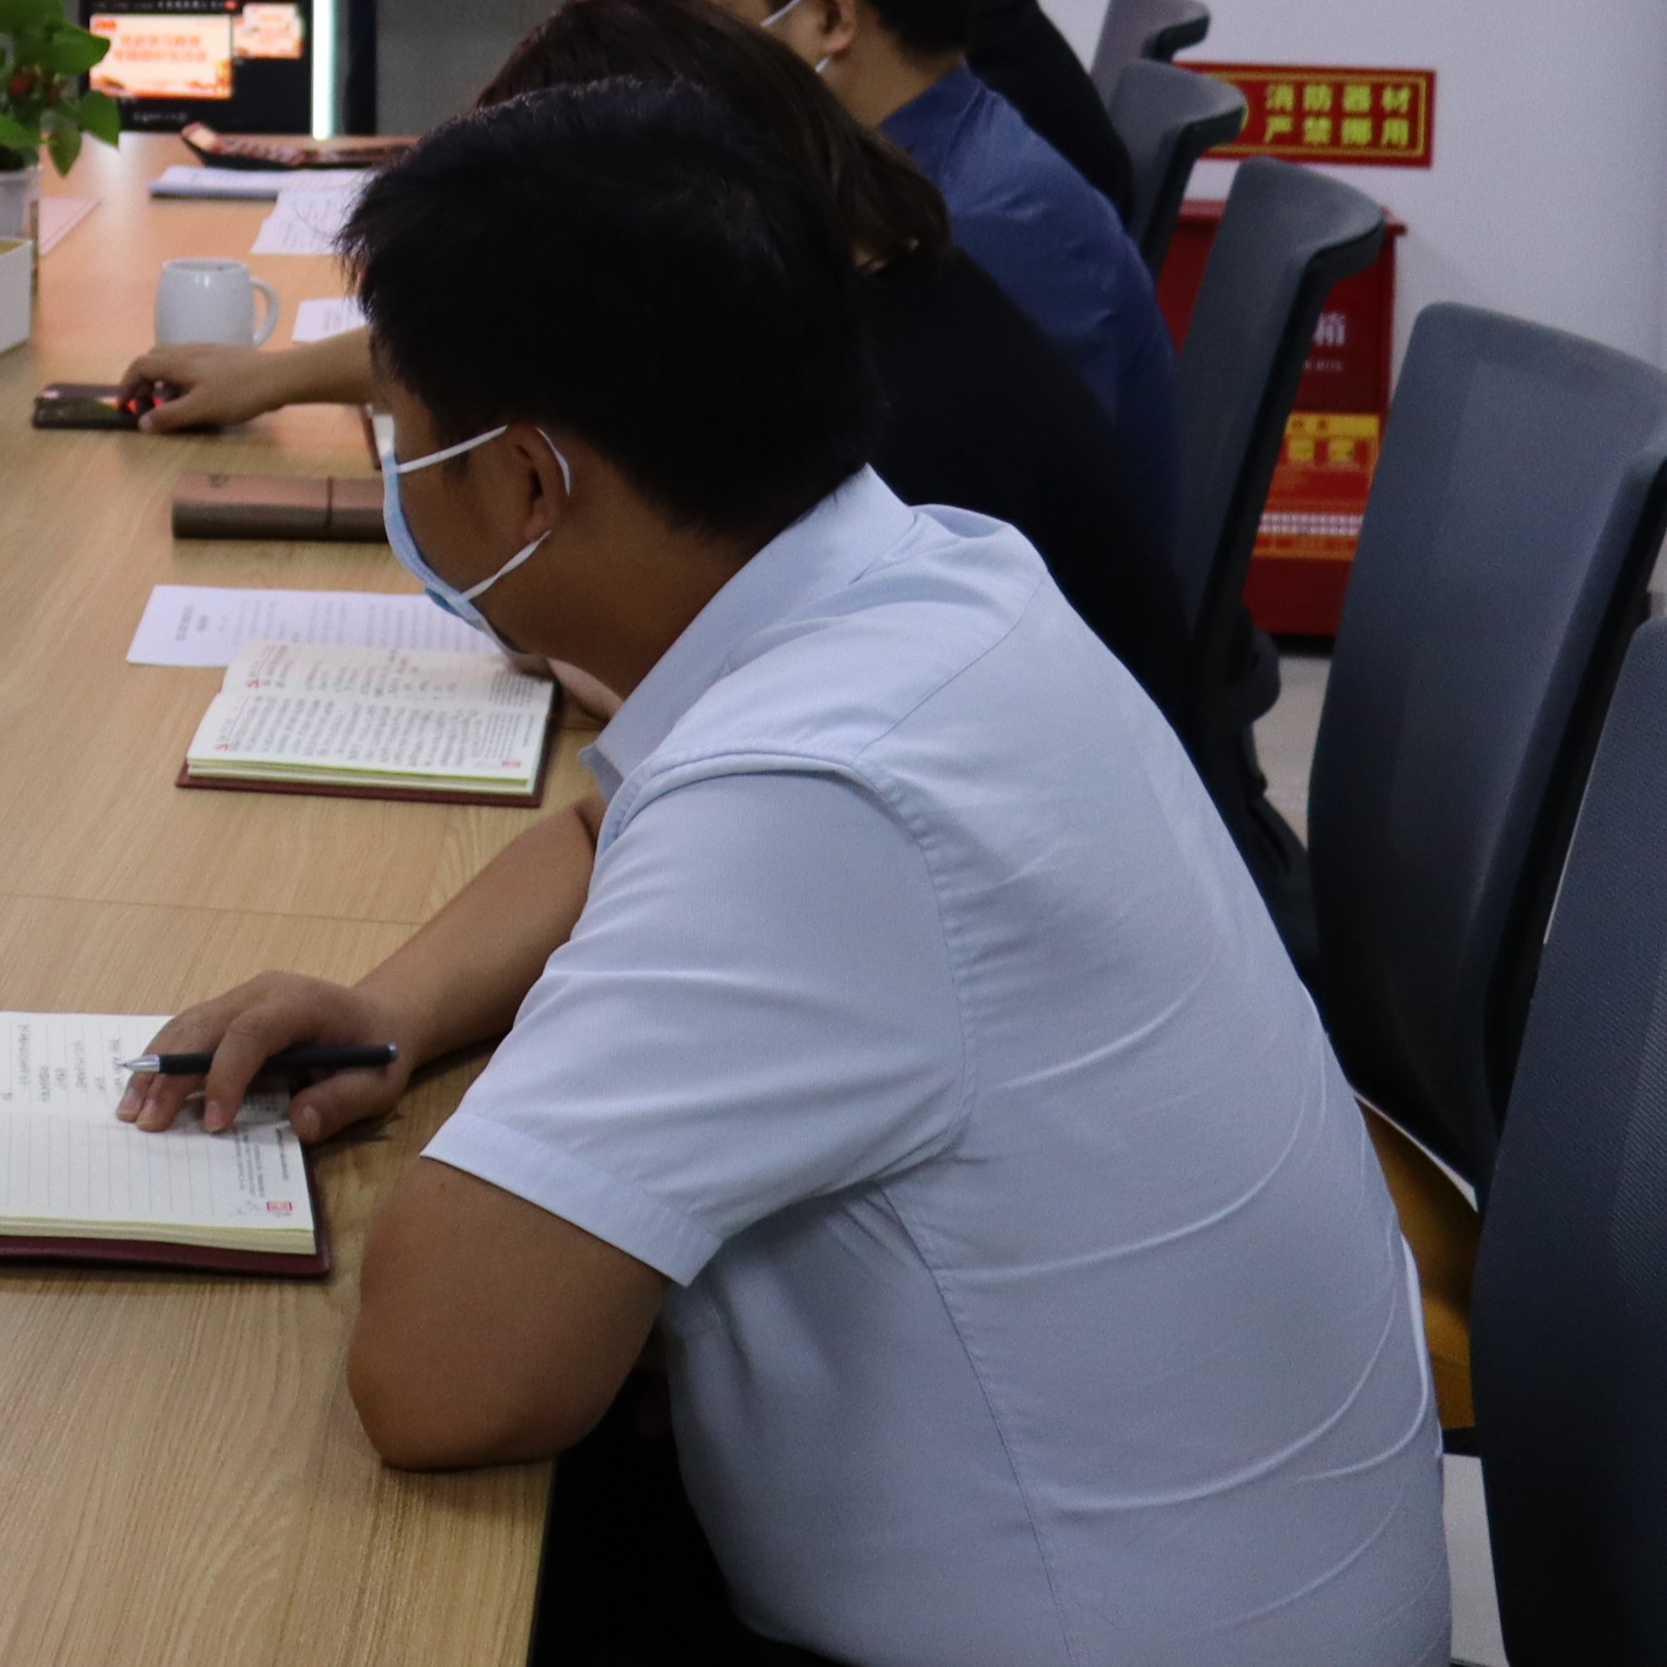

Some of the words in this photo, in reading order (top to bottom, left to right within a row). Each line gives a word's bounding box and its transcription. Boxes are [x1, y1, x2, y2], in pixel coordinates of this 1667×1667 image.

[1266, 84, 1411, 113] 消防器材
[1264, 116, 1410, 146] 严禁挪用
